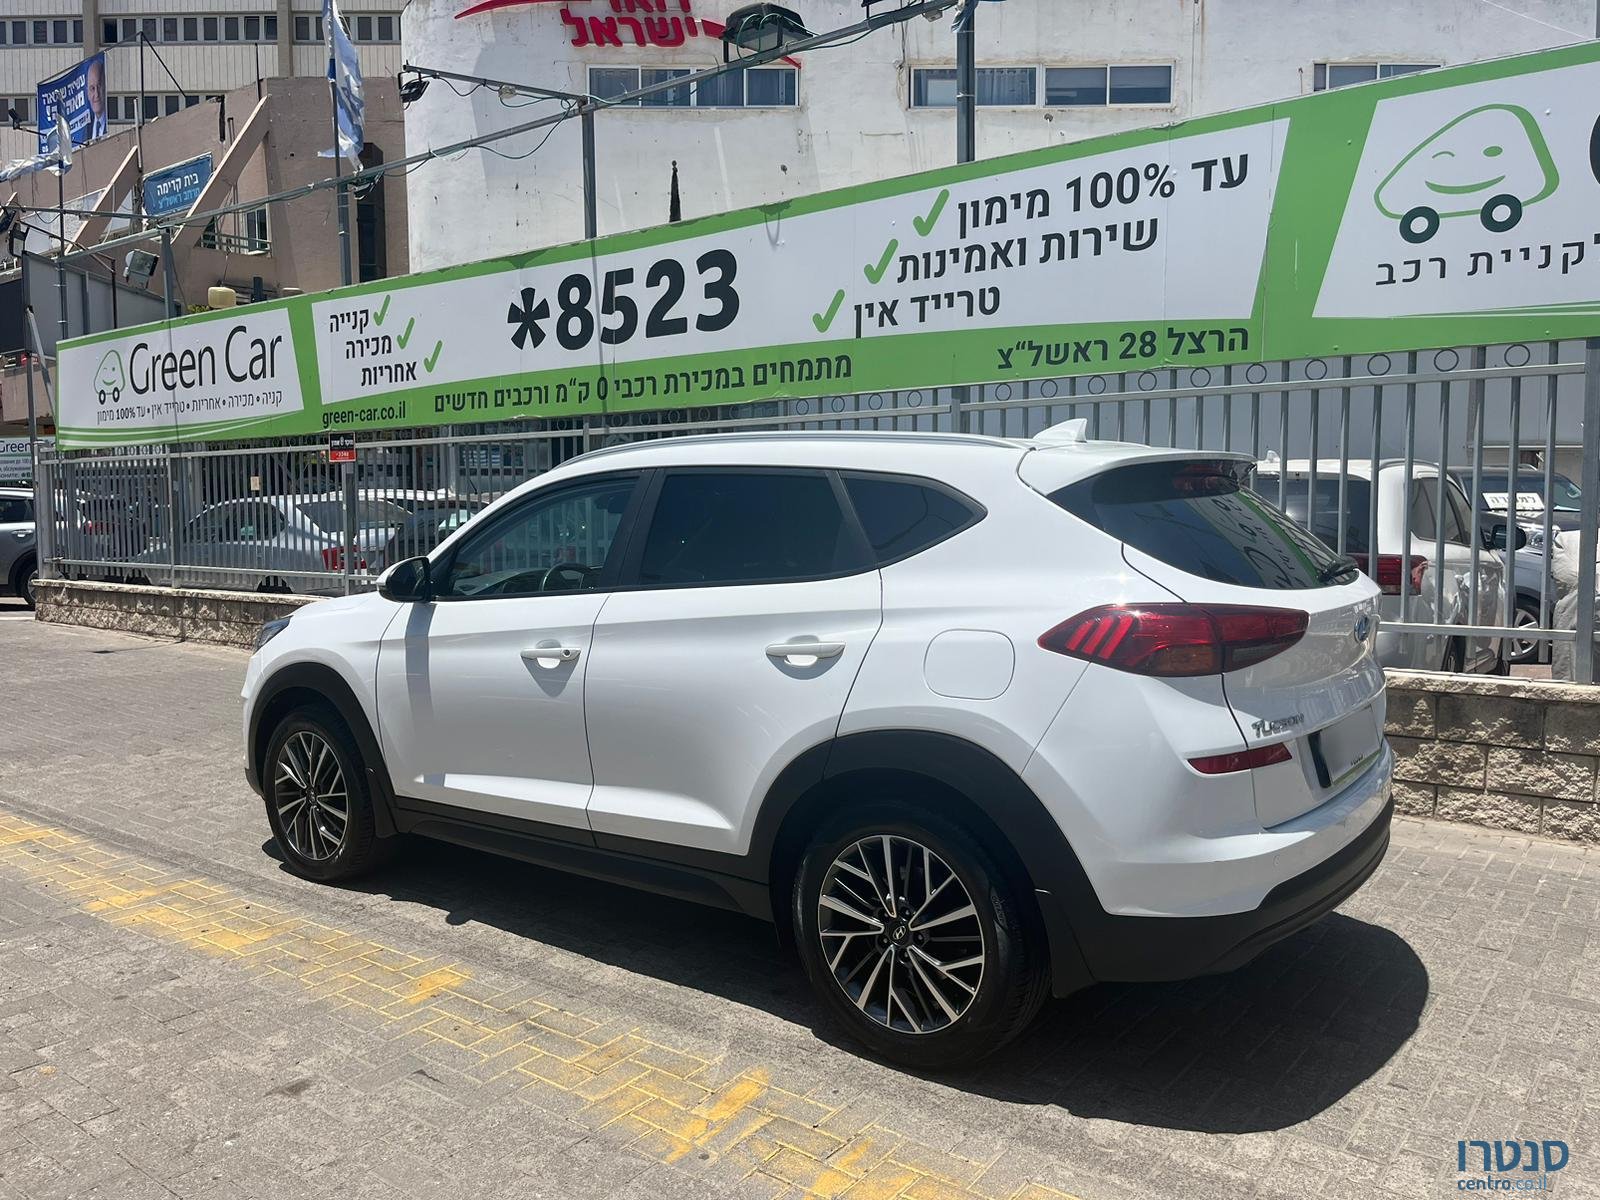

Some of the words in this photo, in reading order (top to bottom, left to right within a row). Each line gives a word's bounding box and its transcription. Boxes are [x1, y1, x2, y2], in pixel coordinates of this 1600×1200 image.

[560, 8, 698, 47] ישראל
[157, 177, 181, 196] קדימה
[184, 173, 199, 187] בית
[1192, 153, 1249, 192] עד
[1065, 162, 1175, 213] 100%
[958, 188, 1049, 240] מימון
[1039, 217, 1158, 264] שירות
[1467, 233, 1600, 275] קניית
[897, 237, 1027, 283] ואמינות
[1375, 256, 1447, 285] רכב
[853, 297, 899, 338] אין
[910, 285, 1000, 324] טרייד
[329, 308, 369, 334] קנייה
[345, 335, 392, 360] מכירה
[1119, 330, 1157, 359] 28
[1167, 327, 1249, 355] הרצל
[130, 342, 216, 396] Green
[225, 325, 282, 383] Car
[361, 361, 417, 387] אחריות
[753, 354, 852, 386] מתמחים
[614, 375, 656, 399] רכבי
[664, 366, 745, 396] במכירת
[192, 396, 220, 412] אחריות
[228, 393, 254, 408] מכירה
[262, 390, 282, 407] קניה
[434, 389, 488, 413] חדשים
[494, 385, 549, 409] ורכבים
[116, 407, 136, 420] 100%
[322, 402, 406, 428] green-car.co.il
